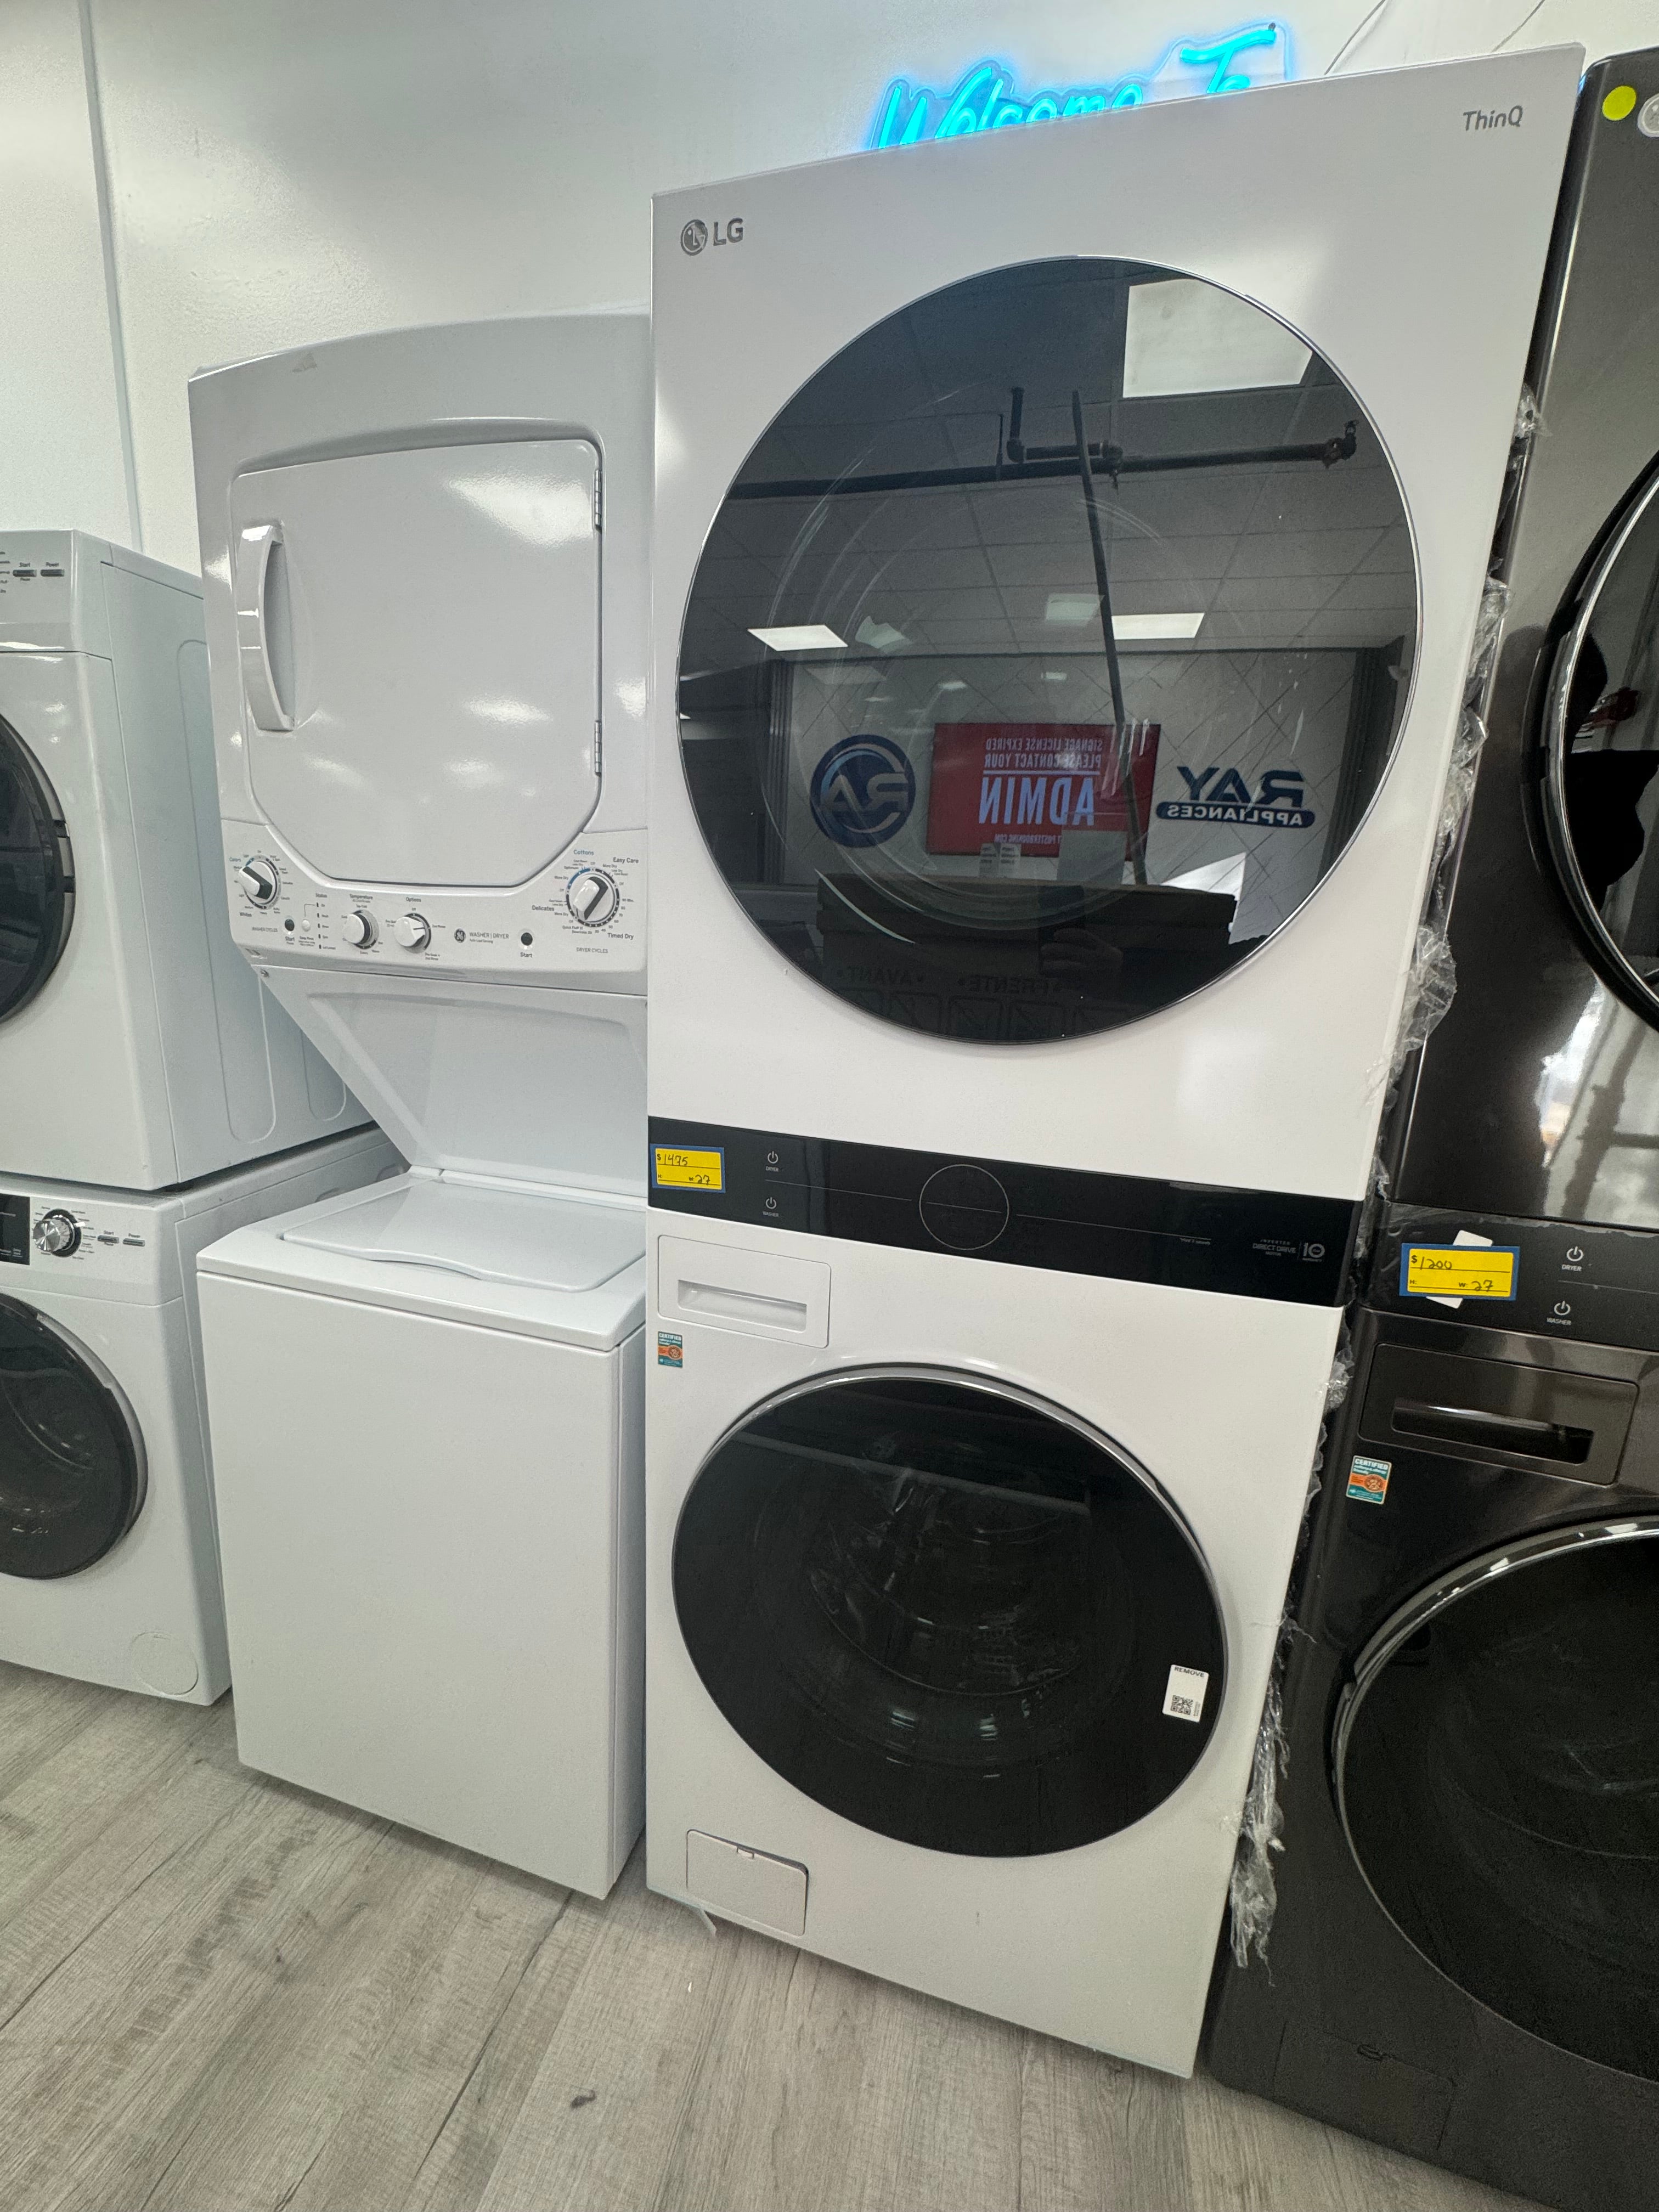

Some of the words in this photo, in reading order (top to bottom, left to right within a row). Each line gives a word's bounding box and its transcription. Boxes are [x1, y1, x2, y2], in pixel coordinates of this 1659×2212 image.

[1463, 105, 1523, 131] ThinQ
[713, 218, 744, 246] LG
[664, 1154, 689, 1166] 1475
[695, 1175, 710, 1186] 27
[1303, 1242, 1325, 1258] 10
[1420, 1256, 1452, 1270] 1200
[1471, 1279, 1493, 1292] 27
[1547, 1317, 1572, 1326] WASHER
[1355, 1458, 1389, 1471] CERTIFIED
[1174, 1666, 1205, 1678] REMOVE
